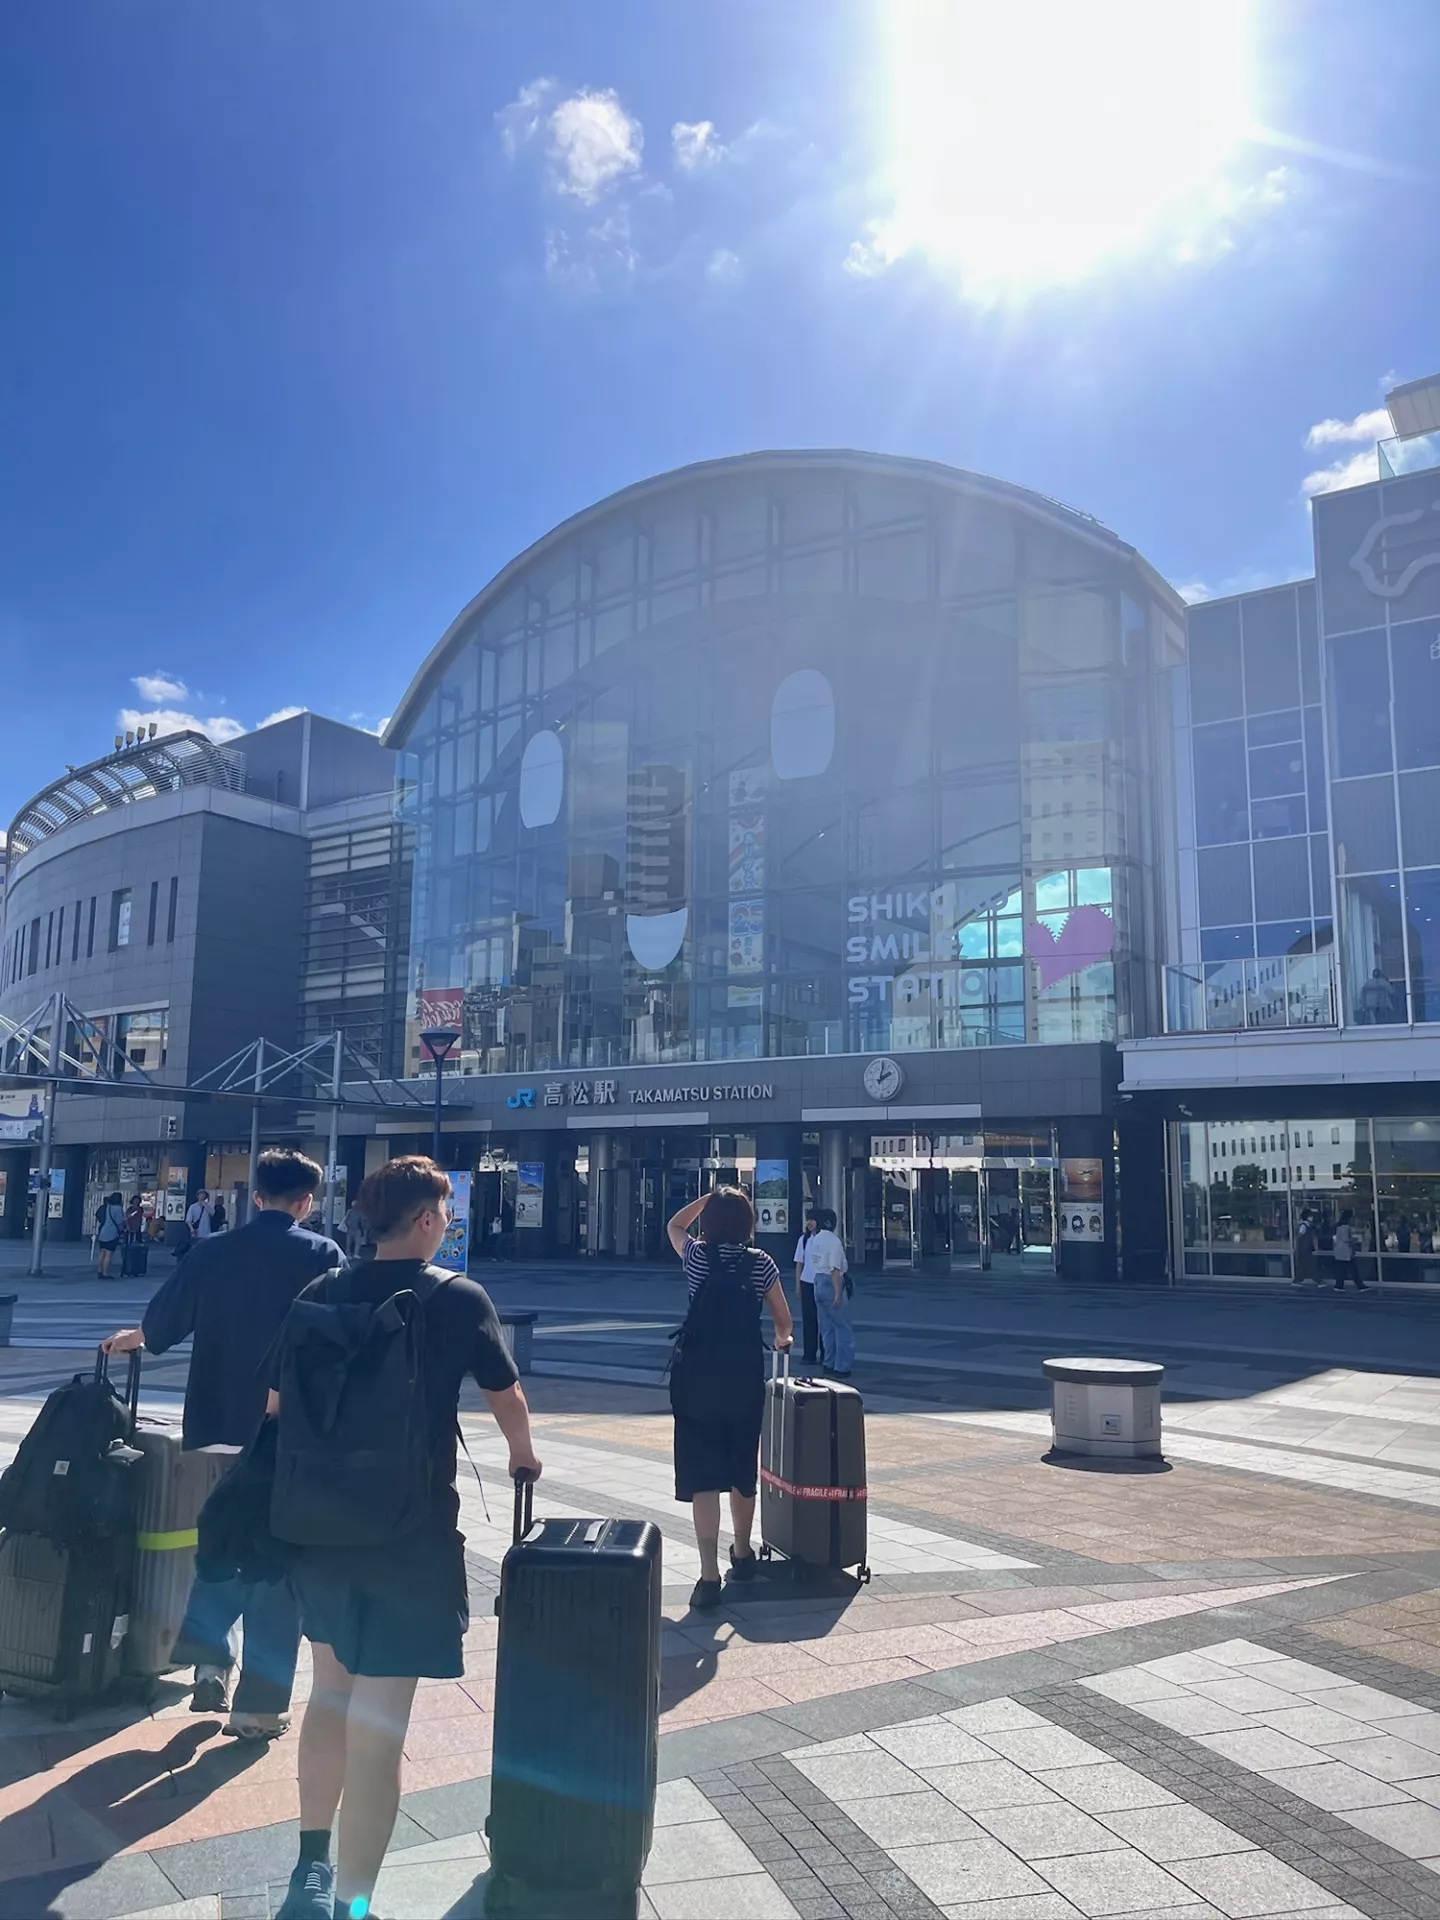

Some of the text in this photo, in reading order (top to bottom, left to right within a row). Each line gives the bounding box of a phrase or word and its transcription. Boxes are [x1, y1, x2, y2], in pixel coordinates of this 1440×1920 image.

[847, 884, 1009, 923] SHIKOKU
[846, 930, 959, 963] SMILE
[848, 967, 1013, 1003] STATION
[506, 1079, 773, 1108] JR 高松駅 TAKAMATSU STATION
[803, 1487, 828, 1498] FRAGILE
